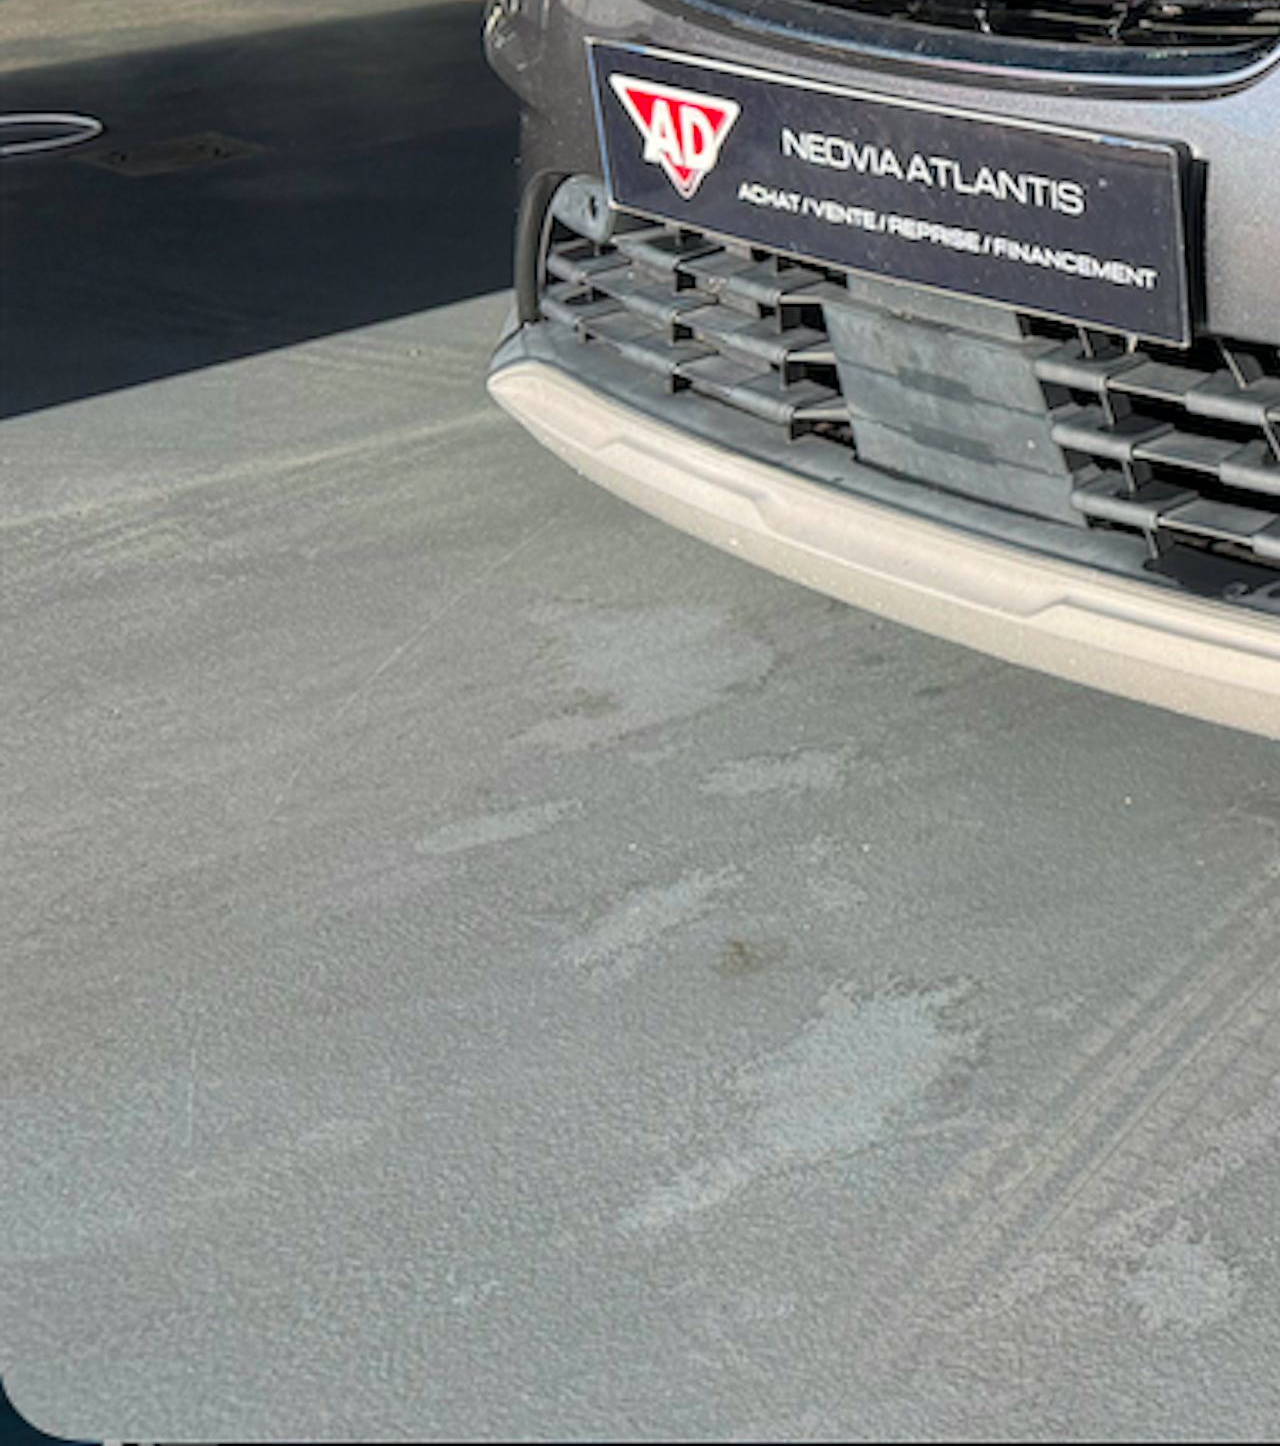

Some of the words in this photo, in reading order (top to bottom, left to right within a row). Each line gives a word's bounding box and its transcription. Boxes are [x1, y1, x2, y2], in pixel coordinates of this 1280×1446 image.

[644, 98, 718, 172] AD
[782, 128, 902, 180] NEOVIA
[906, 154, 1085, 216] ATLANTIS
[737, 183, 801, 213] ACHAT
[811, 198, 878, 231] VENTE
[886, 214, 980, 254] REPRISE
[993, 237, 1159, 290] FINANCEMENT
